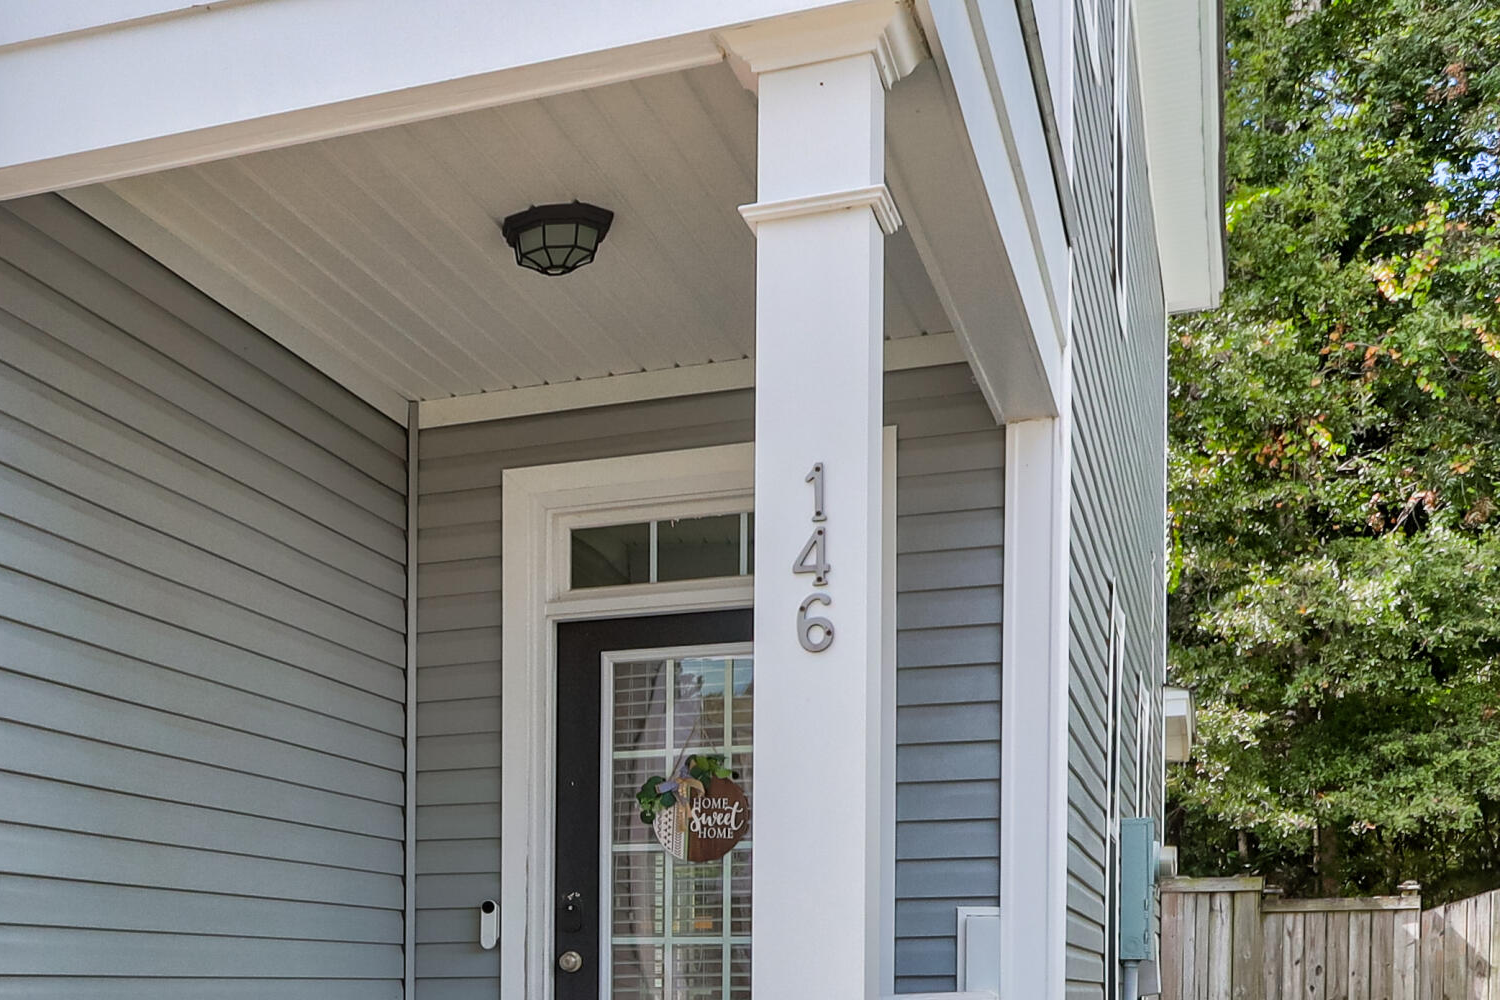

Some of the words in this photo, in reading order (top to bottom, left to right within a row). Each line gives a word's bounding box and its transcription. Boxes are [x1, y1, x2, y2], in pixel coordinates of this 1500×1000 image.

[792, 462, 835, 653] 146
[693, 798, 728, 809] HOME
[698, 828, 734, 839] HOME
